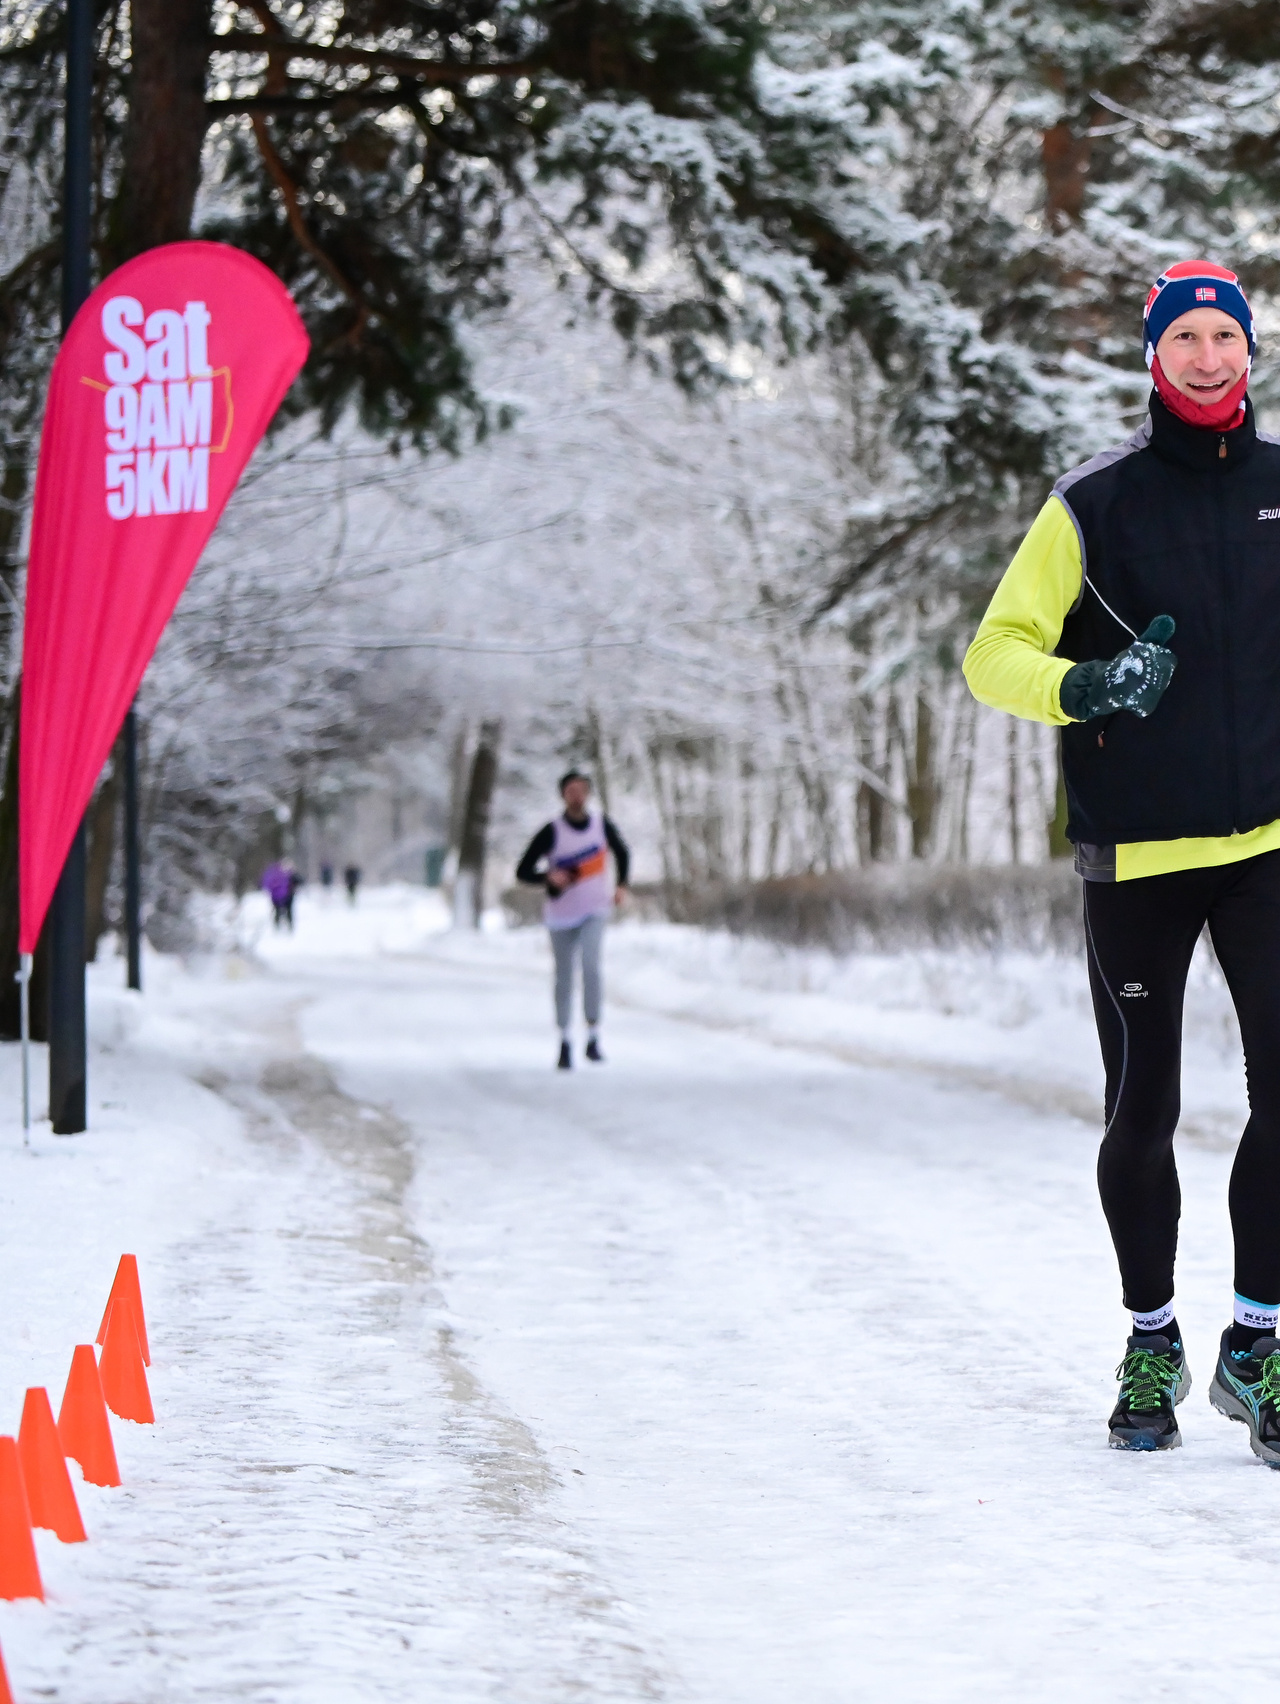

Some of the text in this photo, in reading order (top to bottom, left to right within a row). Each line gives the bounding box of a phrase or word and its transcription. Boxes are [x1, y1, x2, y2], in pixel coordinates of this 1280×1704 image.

[102, 296, 211, 384] Sat
[105, 381, 213, 451] 9AM
[105, 447, 209, 520] 5KM
